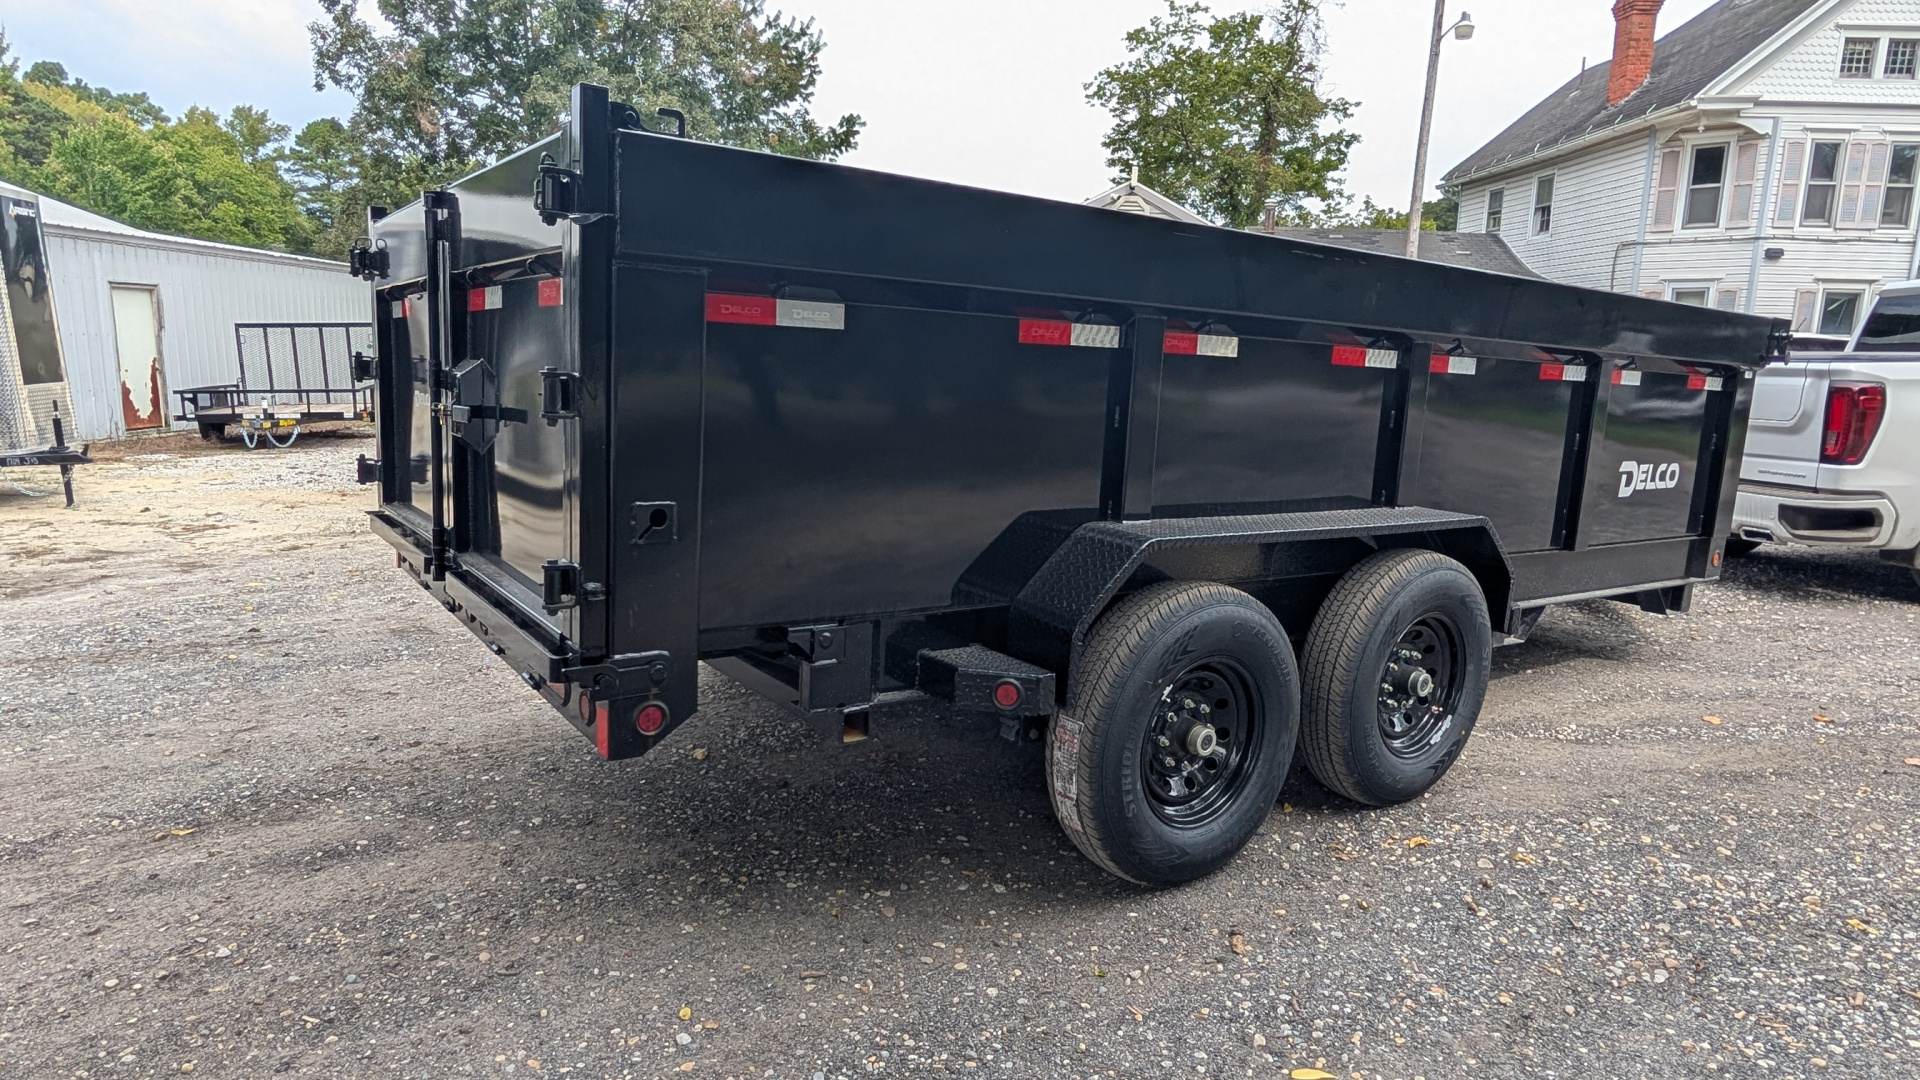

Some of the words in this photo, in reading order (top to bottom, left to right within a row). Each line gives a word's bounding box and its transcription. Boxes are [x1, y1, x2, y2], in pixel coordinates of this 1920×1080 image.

[720, 304, 761, 314] DELCO
[792, 309, 830, 319] DELCO
[1618, 461, 1680, 498] DELCO
